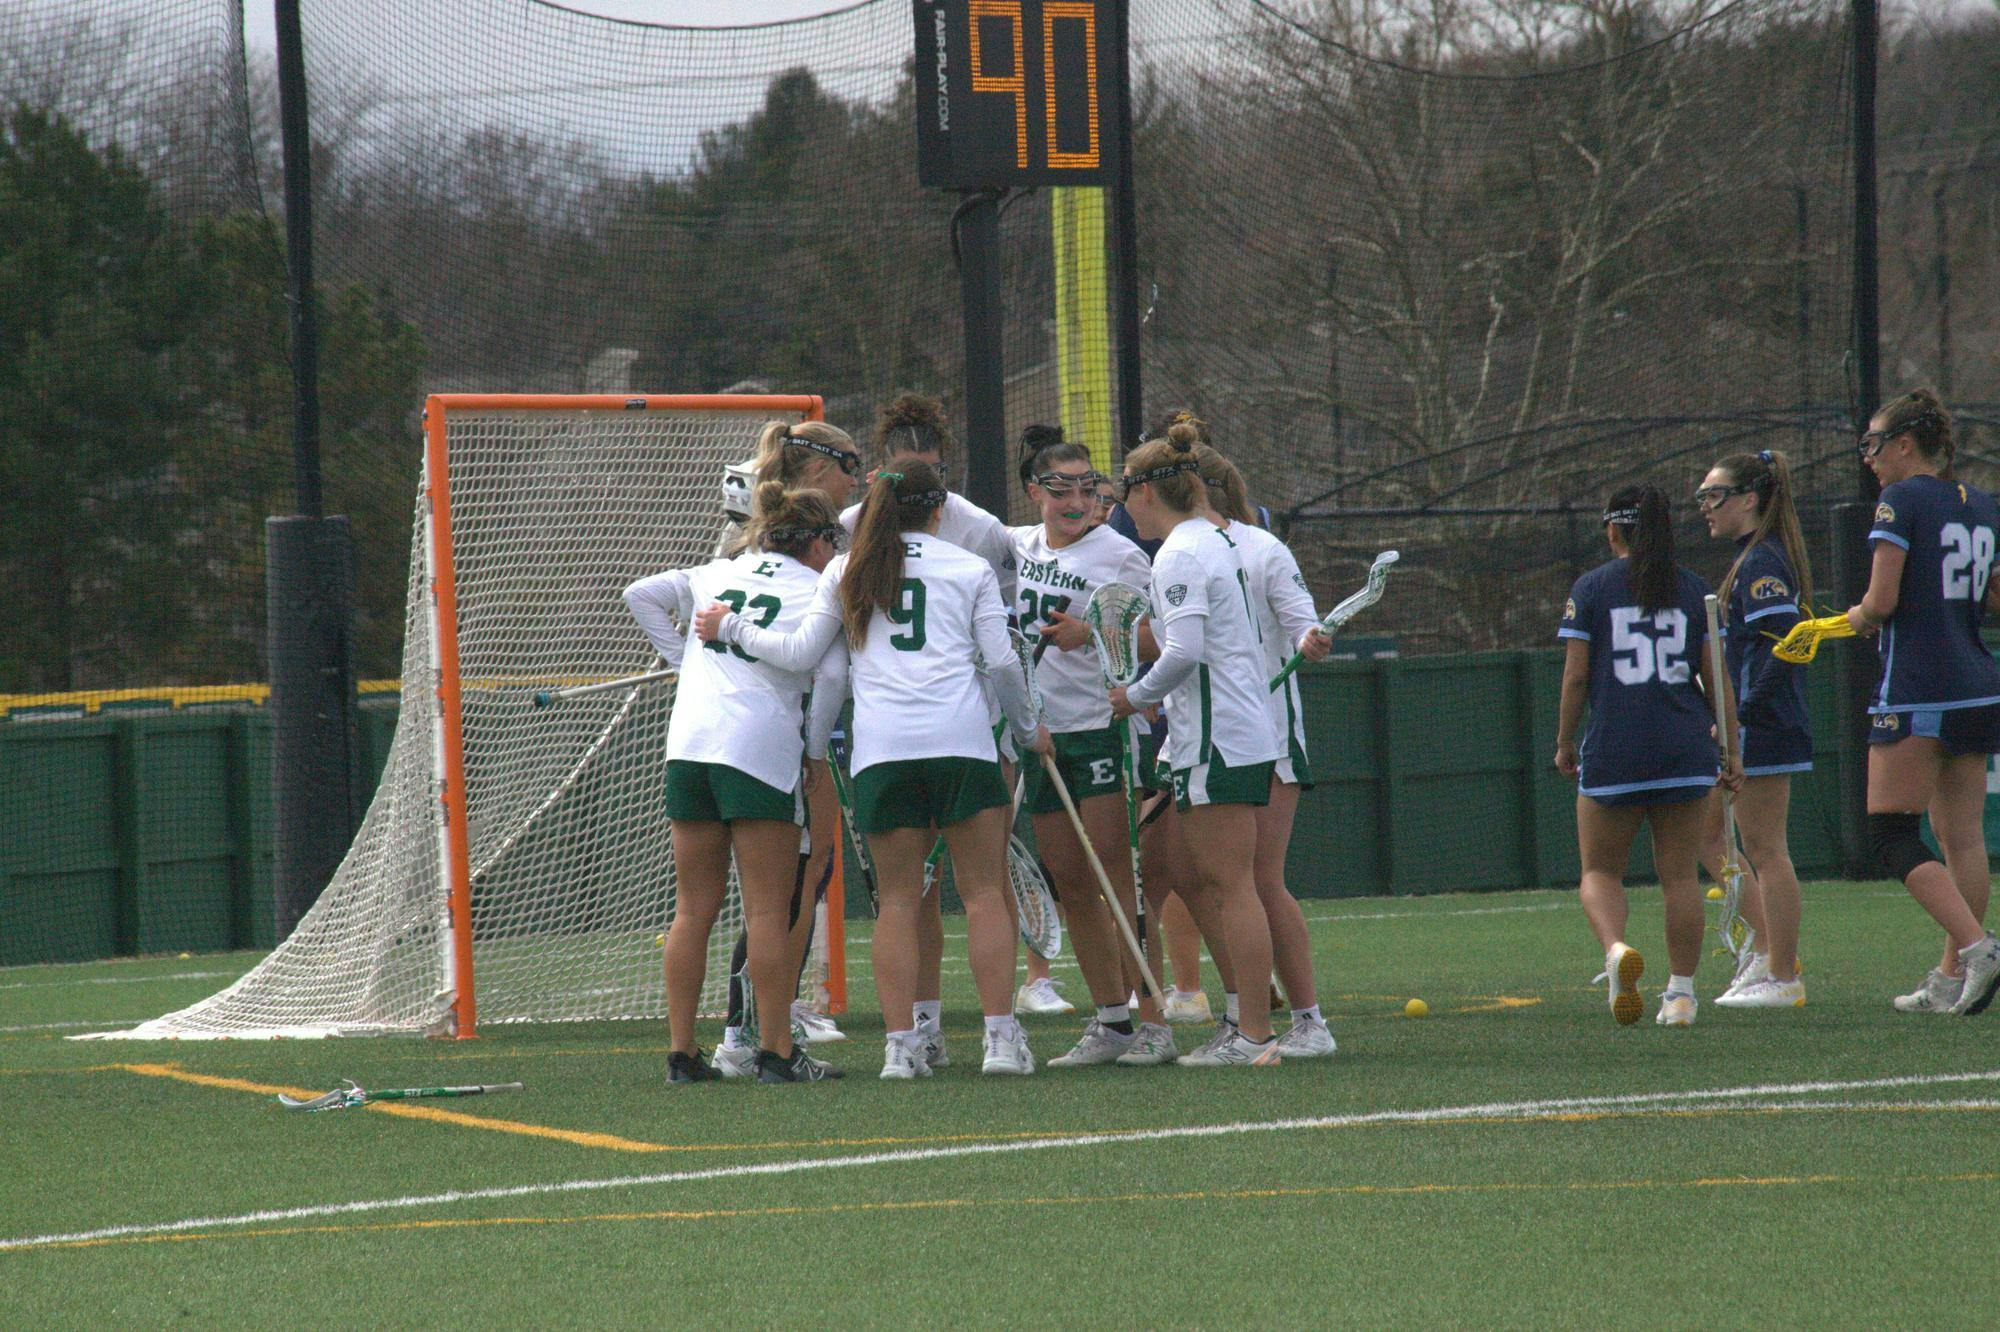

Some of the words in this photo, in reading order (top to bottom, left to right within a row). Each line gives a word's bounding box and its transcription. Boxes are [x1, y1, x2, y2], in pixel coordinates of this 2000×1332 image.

[968, 0, 1100, 168] 90
[752, 560, 782, 578] E
[904, 542, 922, 558] E
[1020, 558, 1088, 591] EASTERN
[1940, 522, 1996, 602] 28
[890, 577, 927, 651] 9
[1609, 606, 1691, 686] 52
[1089, 757, 1116, 785] E
